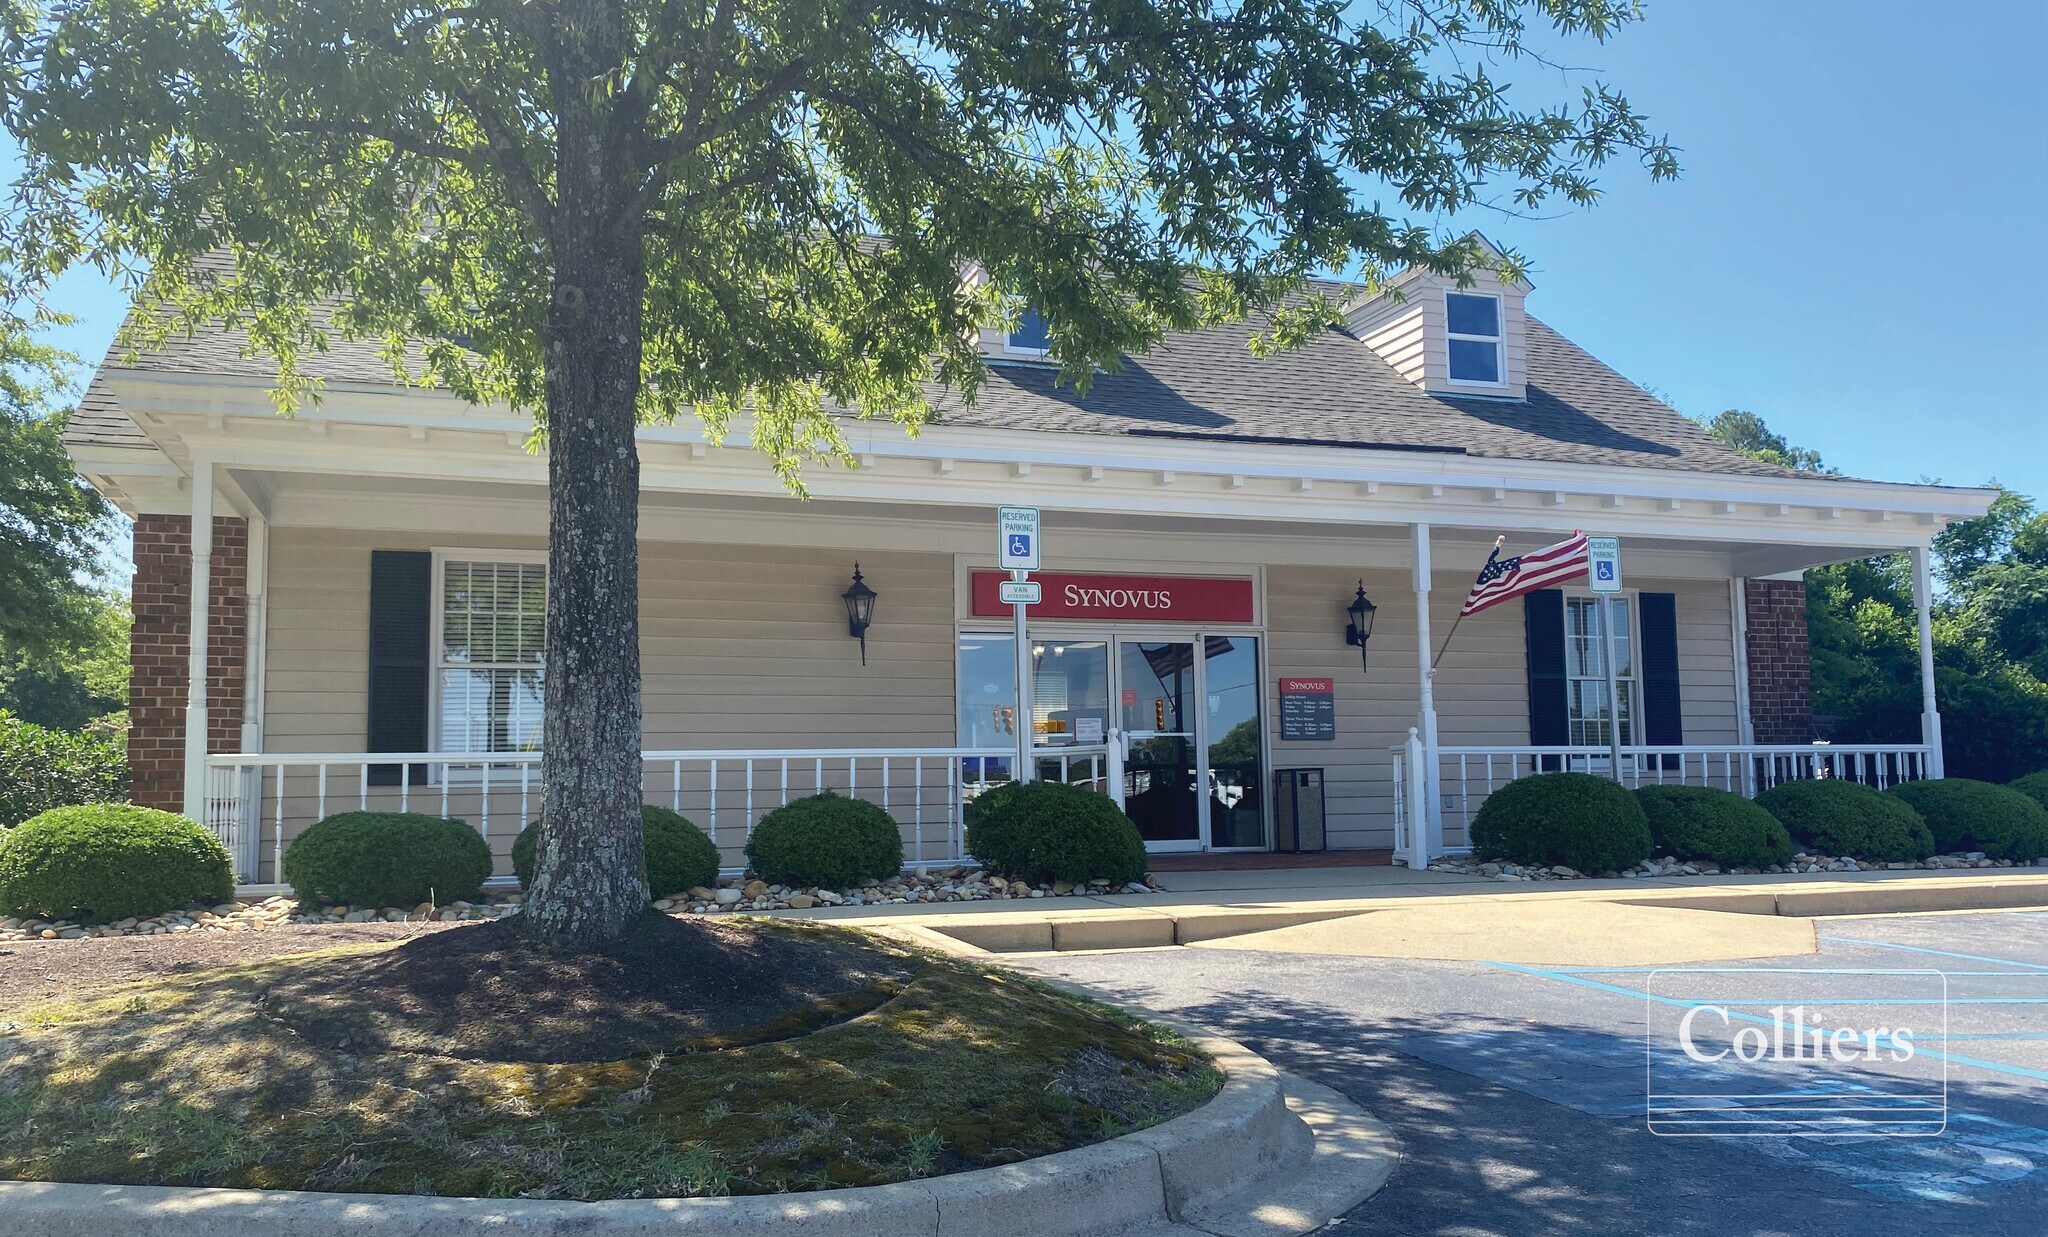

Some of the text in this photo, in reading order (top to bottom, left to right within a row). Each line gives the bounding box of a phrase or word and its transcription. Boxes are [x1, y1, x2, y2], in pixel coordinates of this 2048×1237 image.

[1002, 512, 1036, 521] RESERVED
[1005, 523, 1033, 532] PARKING
[1590, 541, 1616, 549] RESERVED
[1064, 584, 1171, 609] SYNOVUS
[1290, 681, 1325, 690] SYNOVUS
